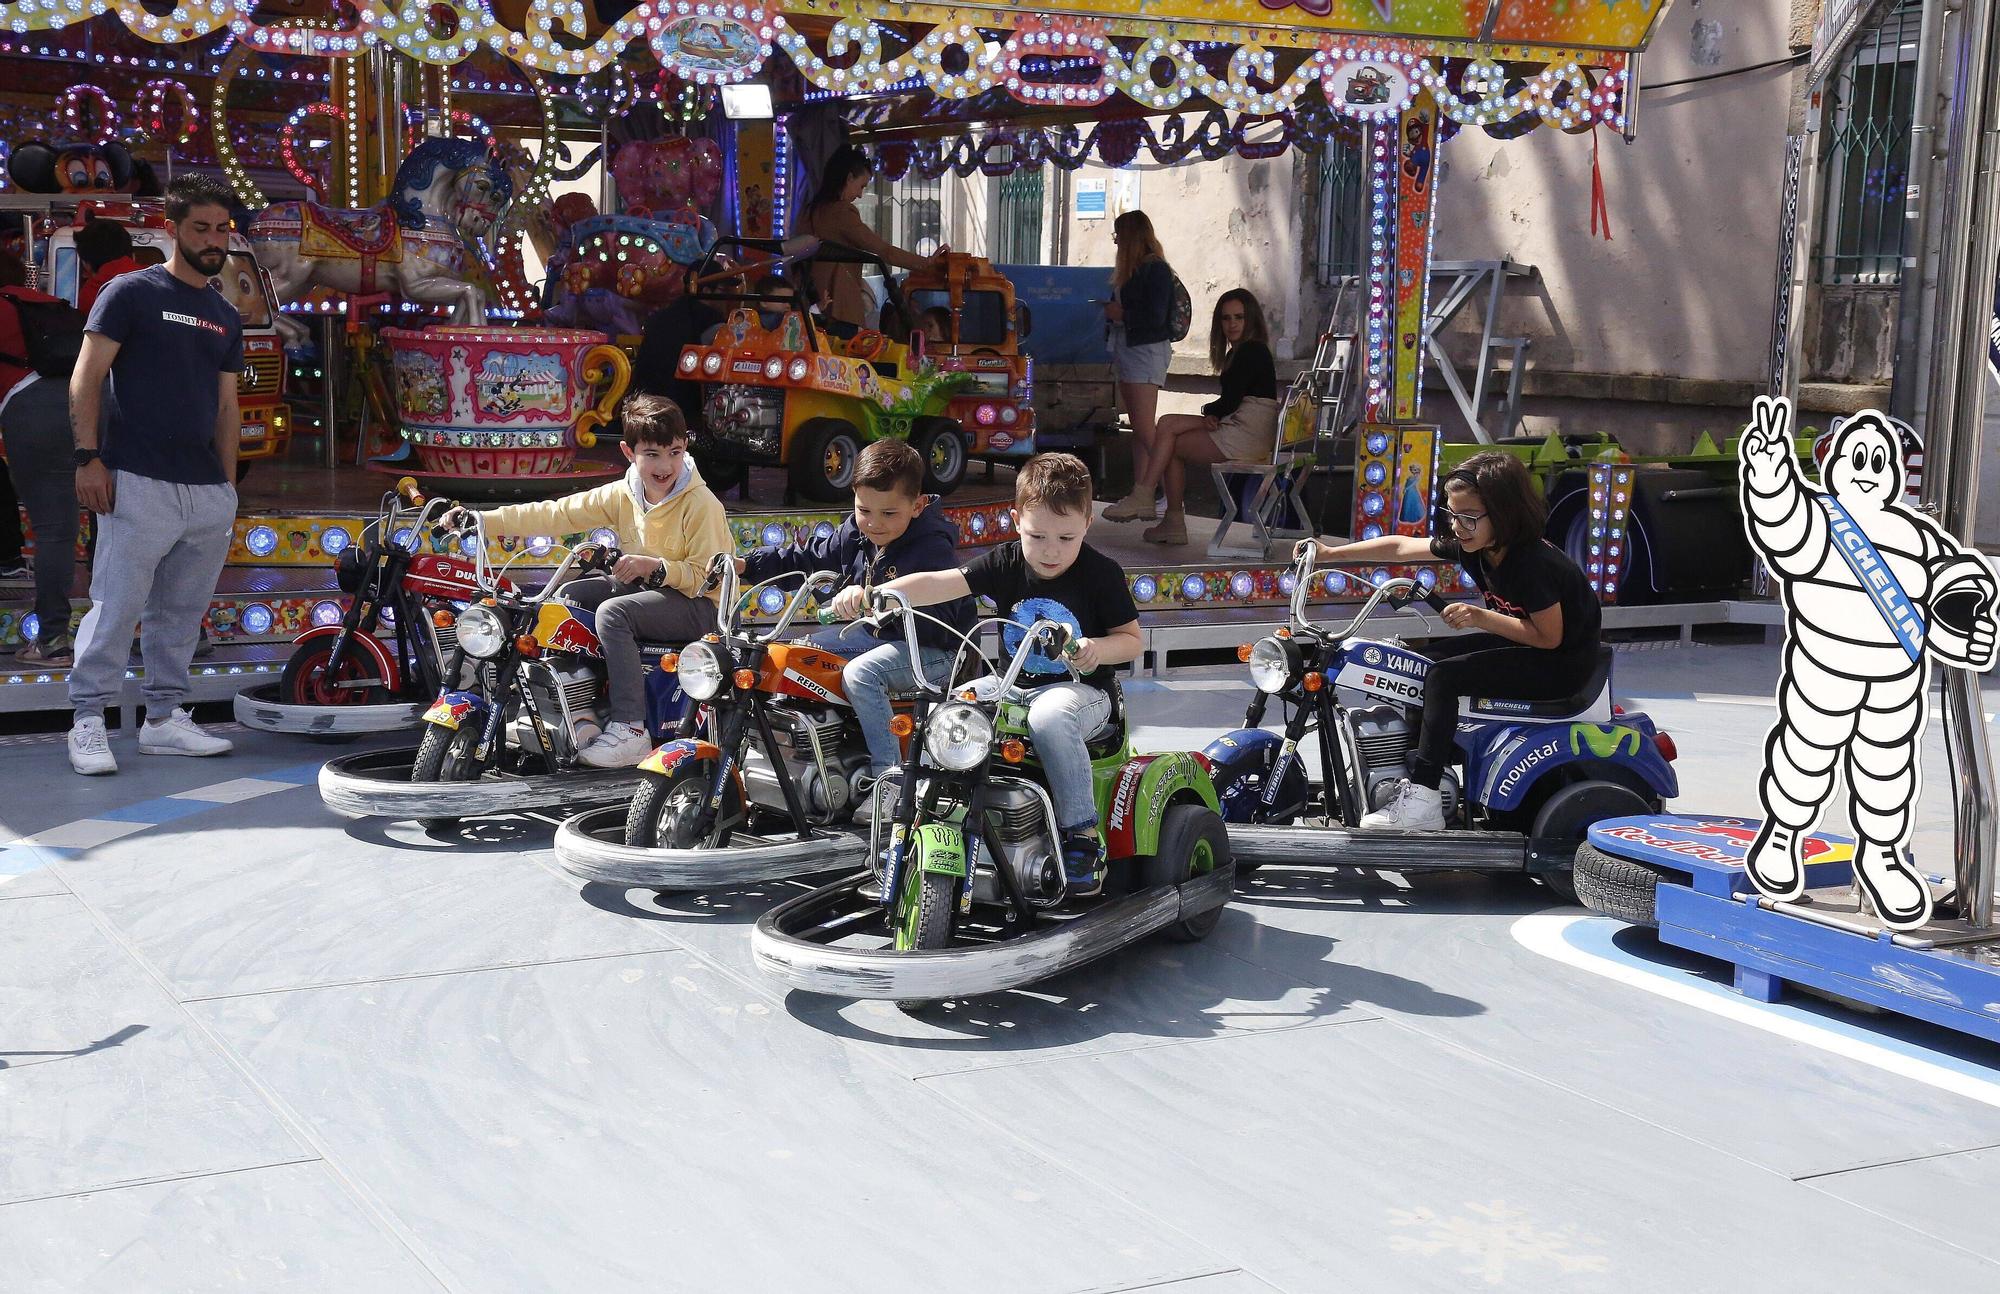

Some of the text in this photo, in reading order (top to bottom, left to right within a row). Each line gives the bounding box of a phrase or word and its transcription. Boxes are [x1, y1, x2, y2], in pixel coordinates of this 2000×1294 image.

[197, 320, 223, 333] JEANS
[1818, 497, 1924, 653] MICHELIN
[1387, 653, 1428, 677] YAMA
[797, 676, 828, 698] REPSOL
[1493, 701, 1531, 710] MICHELIN
[483, 703, 498, 740] MICHELIN
[718, 756, 733, 793] MICHELIN
[1266, 758, 1286, 802] MICHELIN
[1498, 740, 1558, 797] movistar
[1597, 826, 1697, 851] Red
[883, 850, 898, 900] MICHELIN
[968, 838, 980, 887] MICHELIN
